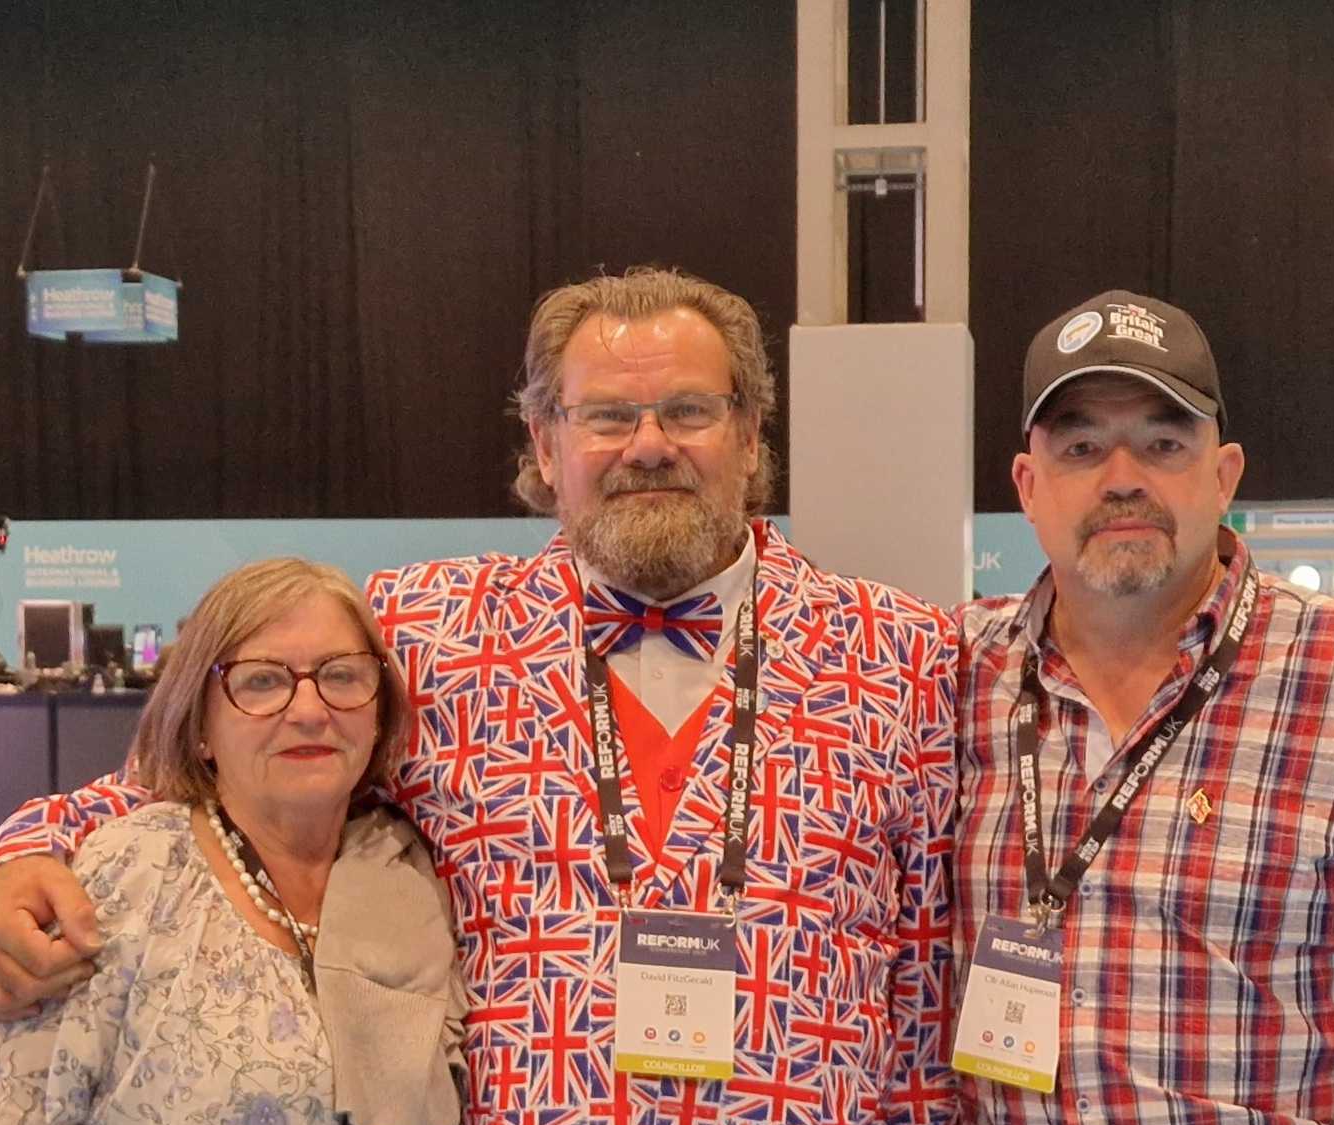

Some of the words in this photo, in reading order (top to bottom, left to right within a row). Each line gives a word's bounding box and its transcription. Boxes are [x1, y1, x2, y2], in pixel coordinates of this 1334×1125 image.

[1110, 312, 1164, 338] Britain
[1115, 325, 1159, 348] Great
[23, 545, 116, 564] Heathrow
[590, 682, 616, 779] REFORMUK
[1112, 715, 1183, 811] REFORMUK
[729, 742, 750, 843] REFORMUK
[637, 932, 721, 951] REFORMUK
